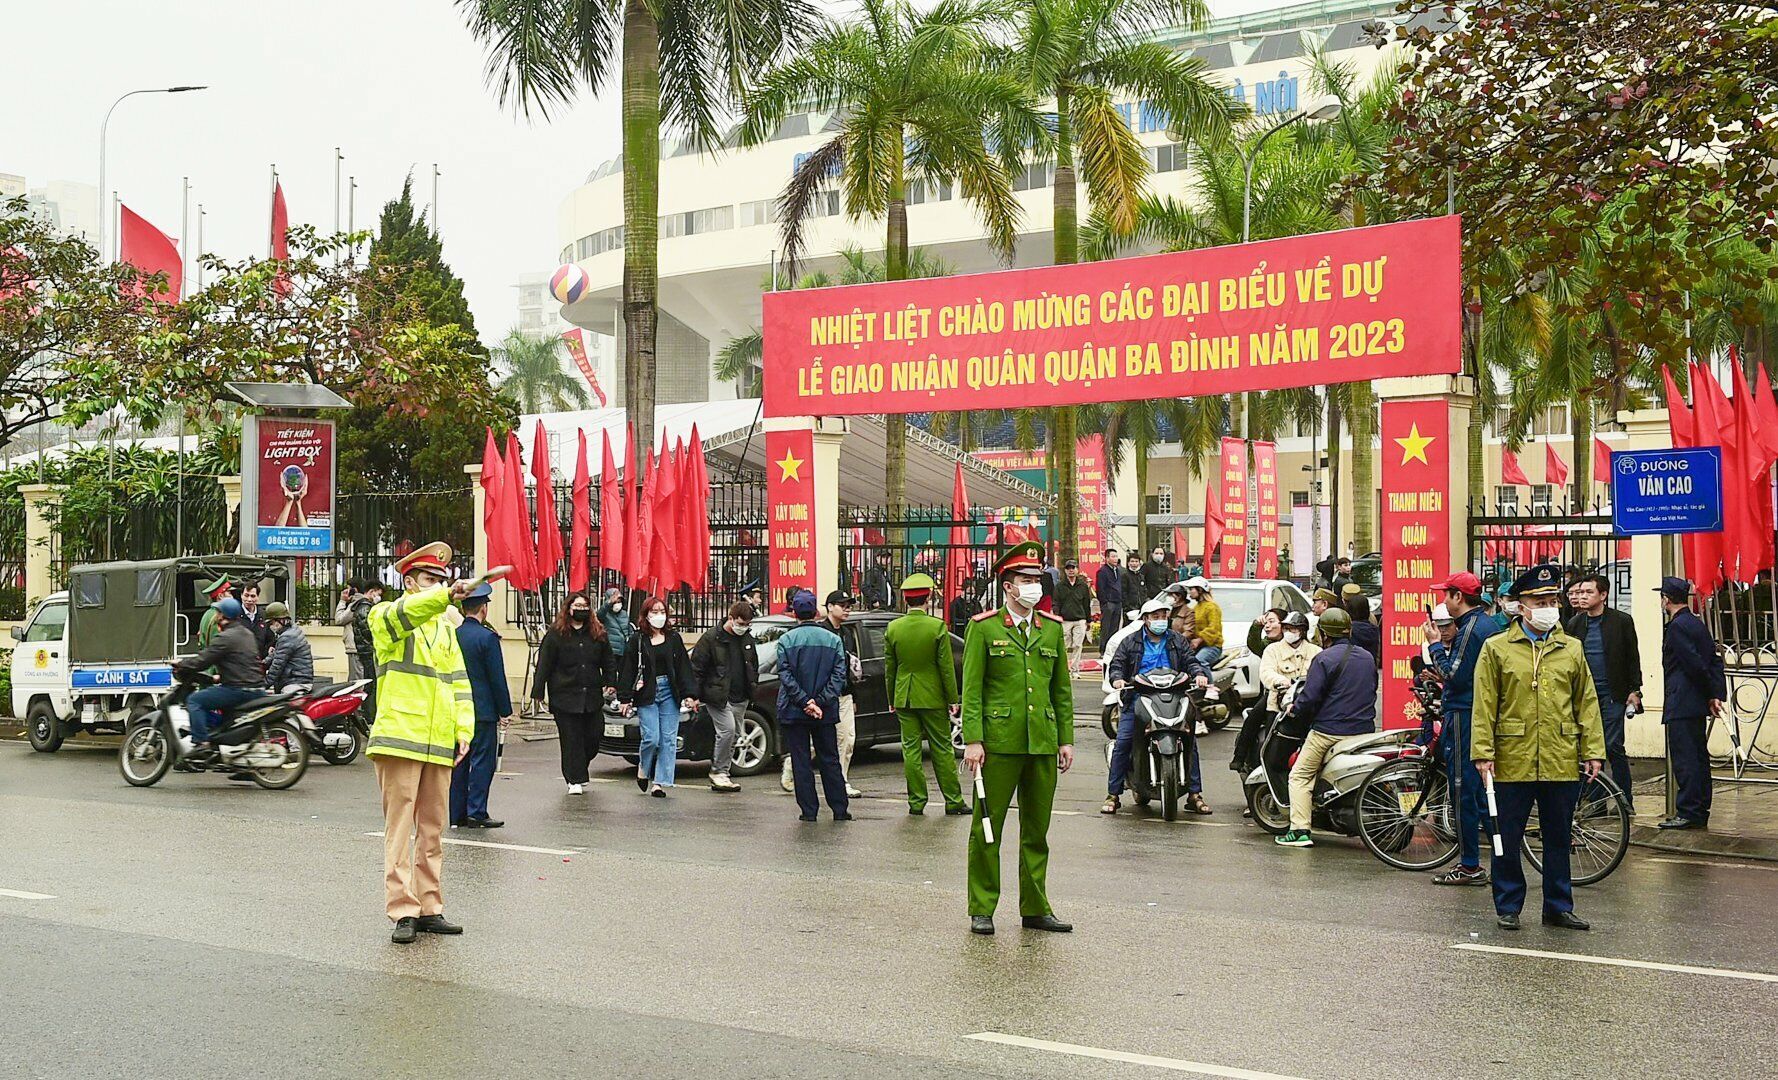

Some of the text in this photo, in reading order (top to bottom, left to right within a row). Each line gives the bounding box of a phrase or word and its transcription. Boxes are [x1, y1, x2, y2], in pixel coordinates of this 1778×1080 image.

[1256, 70, 1298, 121] NỘI
[811, 255, 1388, 349] NHIỆT LIỆT CHÀO MỪNG CÁC ĐẠI BIỂU VỀ DỰ
[798, 318, 1406, 397] LỄ GIAO NHẬN QUÂN QUẬN BA ĐÌNH NĂM 2023
[277, 428, 314, 440] TIẾT KIỆM
[264, 446, 322, 458] LIGHT BOX
[1640, 458, 1689, 471] ĐƯỜNG
[1638, 474, 1692, 496] VĂN CAO
[1388, 488, 1442, 512] THANH NIÊN
[775, 502, 808, 524] XÂY DỰNG
[267, 536, 321, 546] 0865 86 87 86
[775, 527, 809, 551] VÀ BẢO VỆ
[1401, 522, 1427, 550] QUẬN
[779, 554, 806, 578] TỔ QUỐC
[1396, 555, 1433, 578] BA ĐÌNH
[773, 584, 781, 604] LÀ
[1394, 589, 1418, 612] HĂNG
[1390, 622, 1407, 645] LÊN
[129, 670, 149, 684] SÁT
